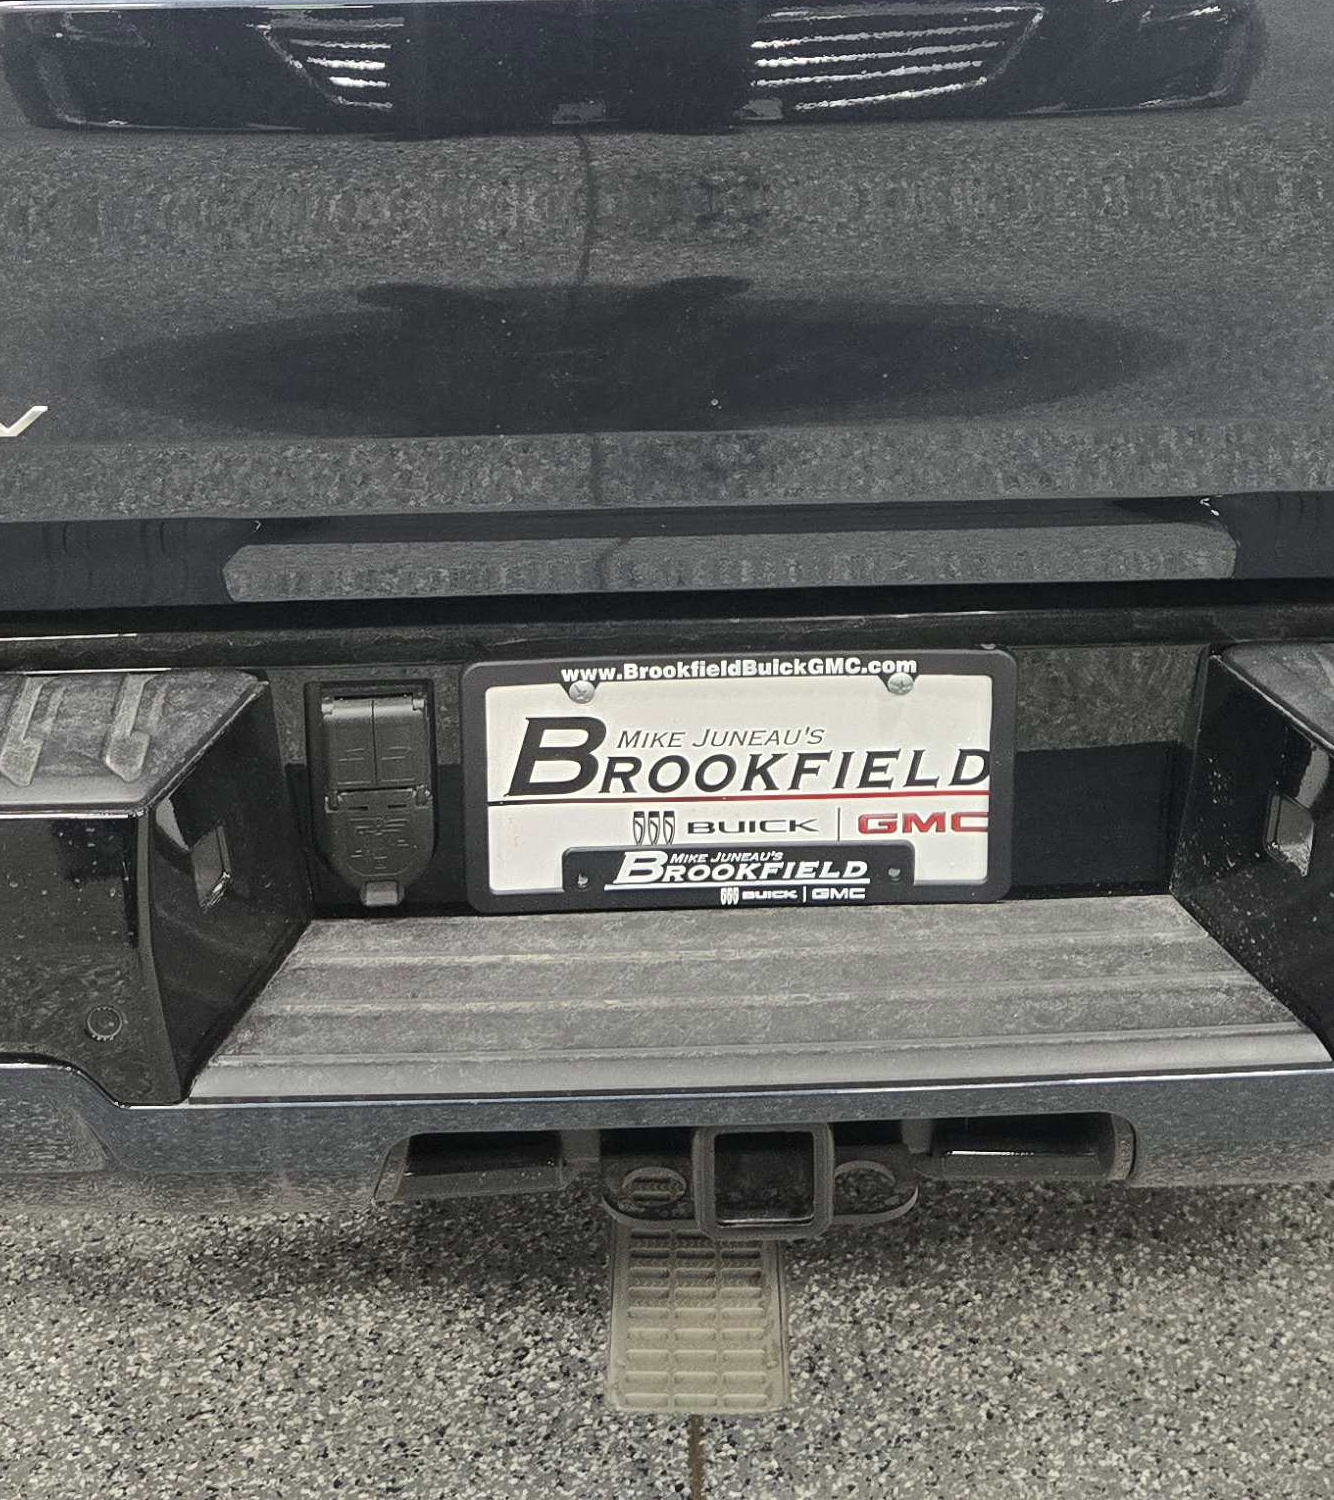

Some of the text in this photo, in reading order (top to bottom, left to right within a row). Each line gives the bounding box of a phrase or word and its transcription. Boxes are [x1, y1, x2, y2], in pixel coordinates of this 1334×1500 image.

[561, 657, 917, 683] www.BrookfieldBuickGMC.com
[616, 726, 826, 749] MIKE JUNEAU'S
[503, 715, 990, 798] BROOKFIELD
[687, 811, 989, 836] BUICK GMC
[613, 850, 868, 884] BROOKFIELD
[669, 851, 784, 864] MIKE JUNEAU'S
[741, 888, 866, 900] BUICK GMC
